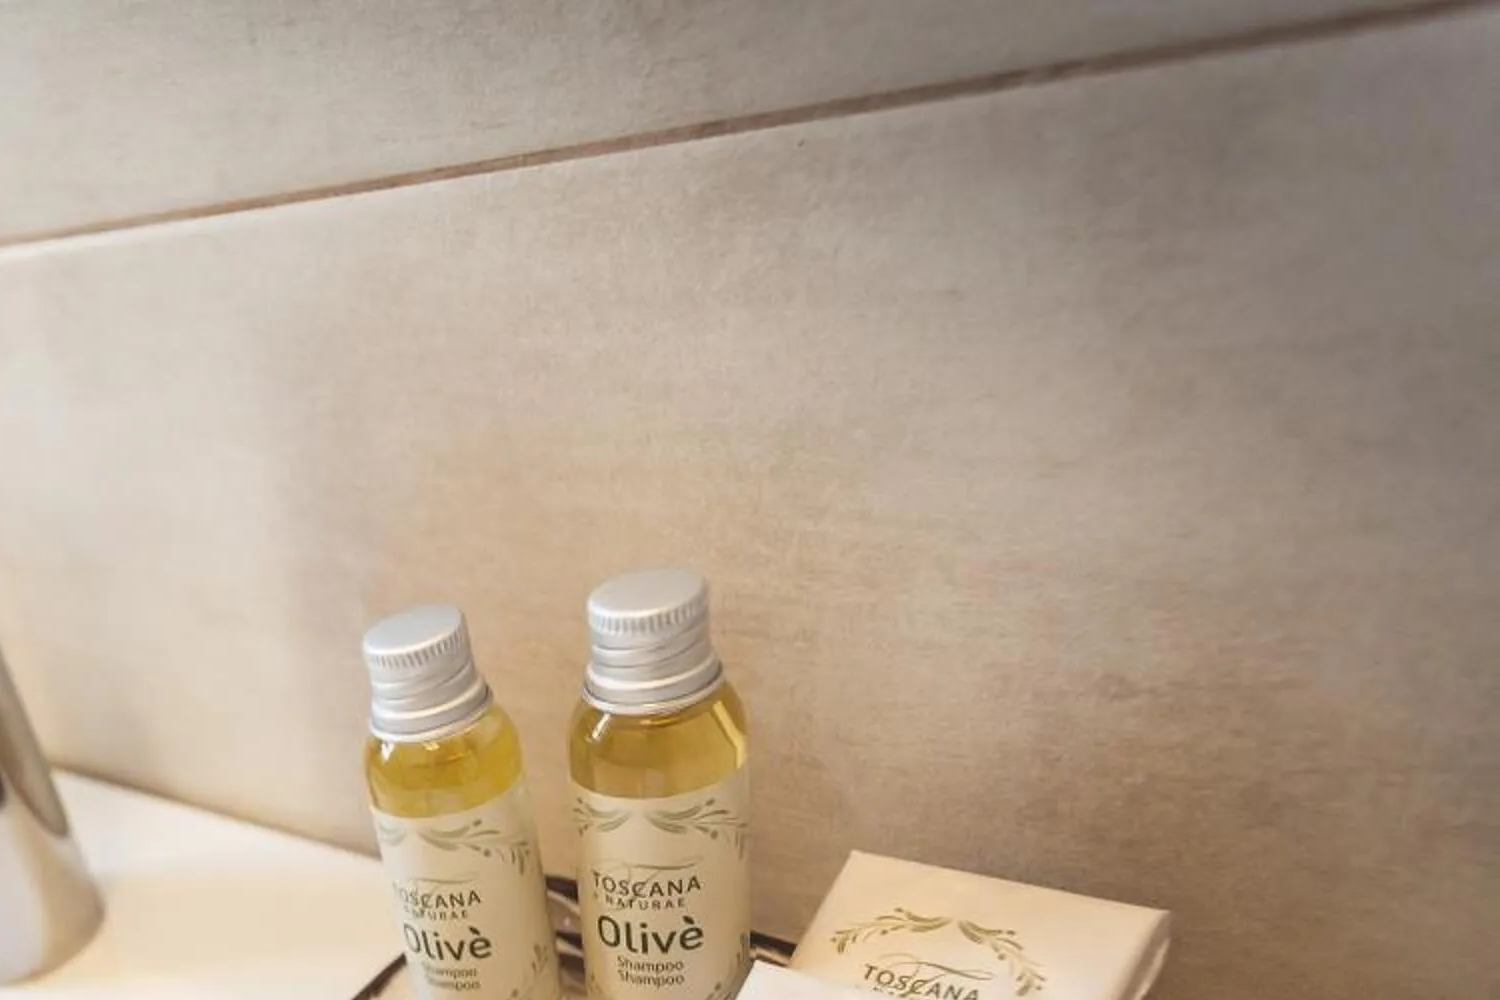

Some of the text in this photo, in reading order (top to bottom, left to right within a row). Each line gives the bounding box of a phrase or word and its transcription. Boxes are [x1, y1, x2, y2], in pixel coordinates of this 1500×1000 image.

[593, 871, 701, 898] TOSCANA
[606, 896, 685, 911] NATURAE
[404, 923, 492, 961] Olivè
[597, 916, 704, 954] Olivè
[617, 955, 684, 973] Shampoo
[617, 970, 685, 988] Shampoo
